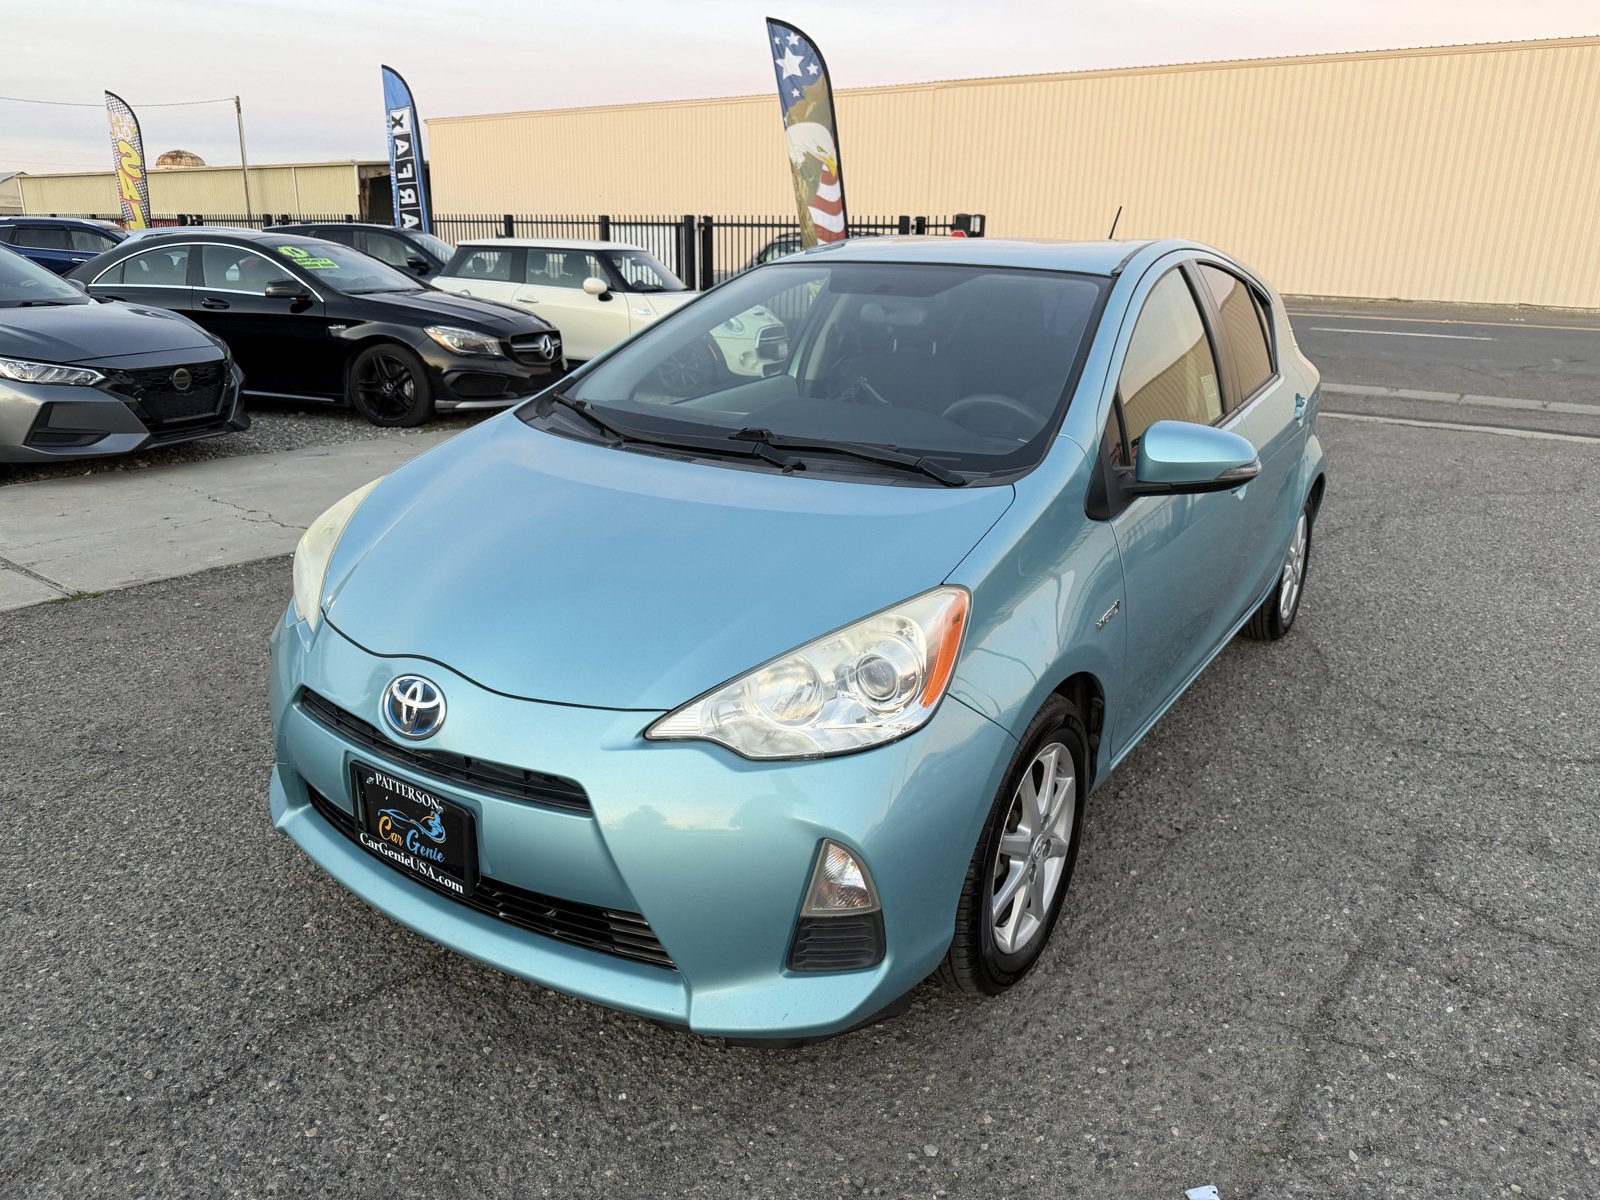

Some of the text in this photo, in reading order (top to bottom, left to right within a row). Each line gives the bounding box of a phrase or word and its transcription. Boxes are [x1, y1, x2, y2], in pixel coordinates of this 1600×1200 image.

[375, 772, 440, 810] PATTERSON
[359, 832, 464, 894] CarGenieUSA.com
[378, 815, 446, 863] Car Genie
